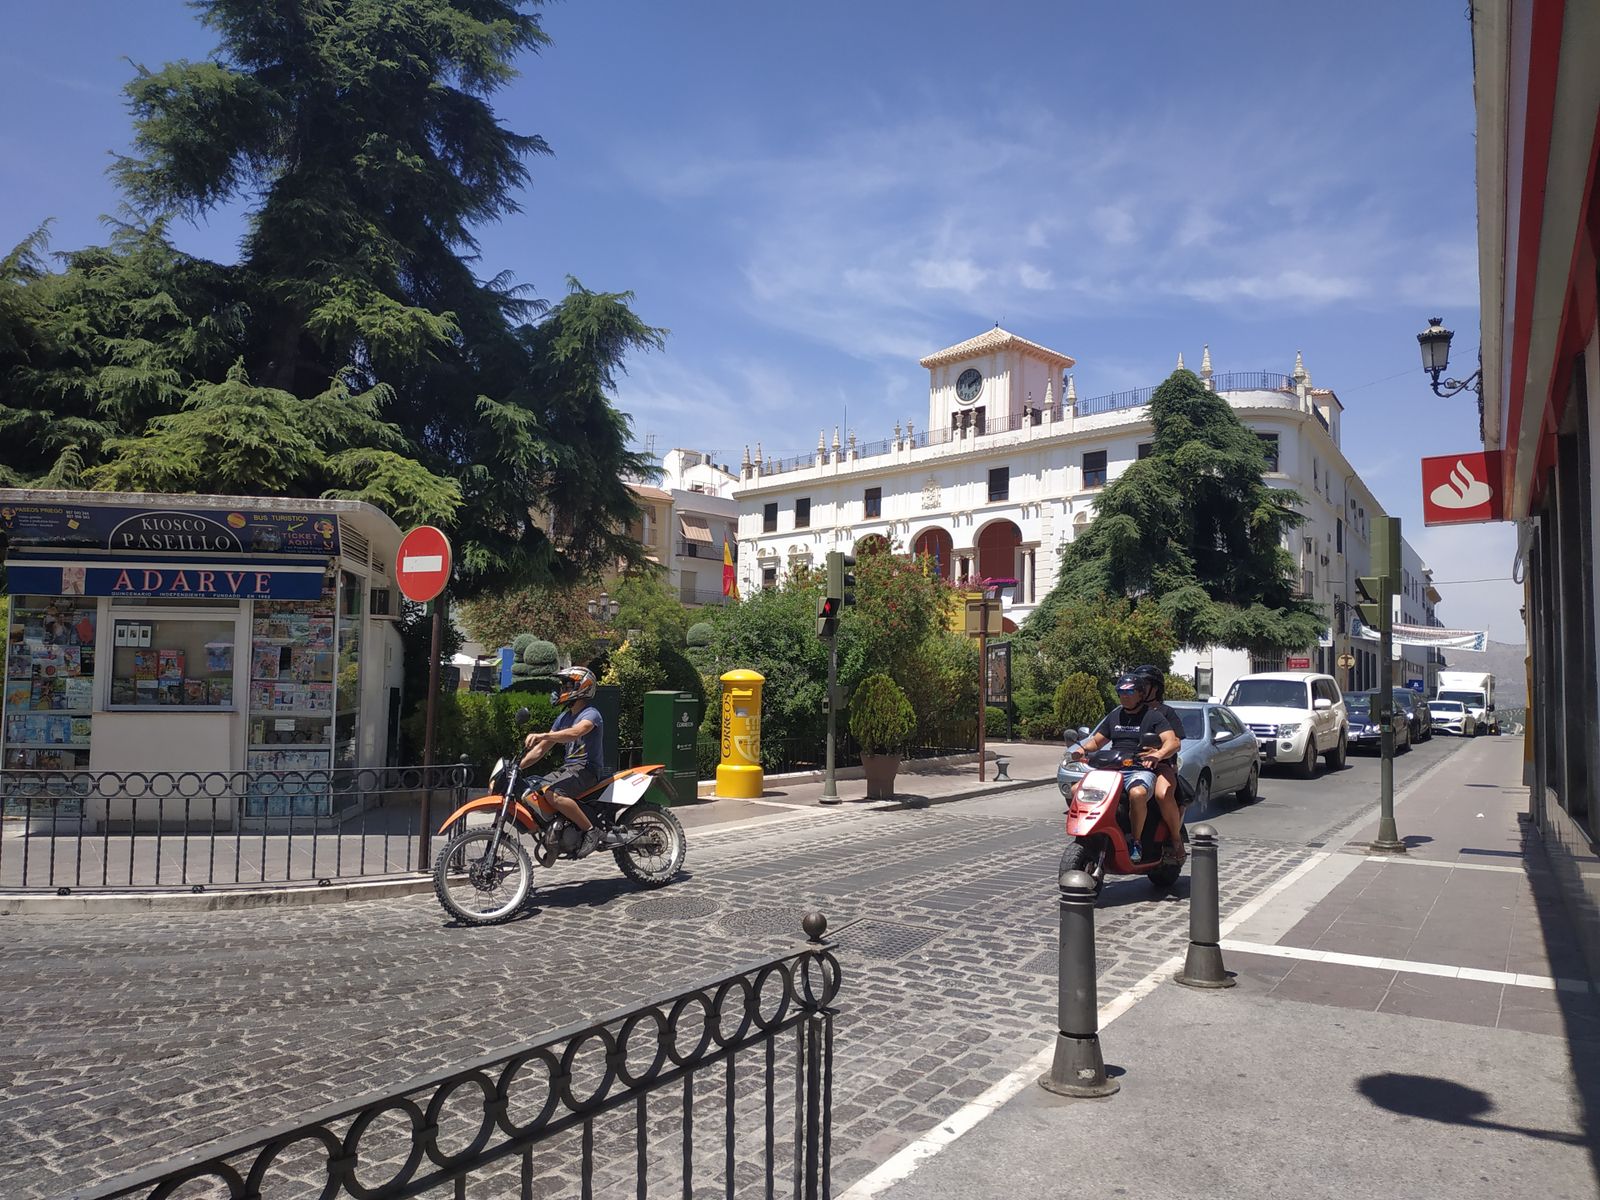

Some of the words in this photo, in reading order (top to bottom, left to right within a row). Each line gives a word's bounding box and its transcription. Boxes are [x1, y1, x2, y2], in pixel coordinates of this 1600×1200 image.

[141, 518, 206, 532] KIOSCO
[122, 532, 231, 550] PASEILLO
[281, 532, 318, 540] TICKET
[112, 570, 271, 594] ADARVE
